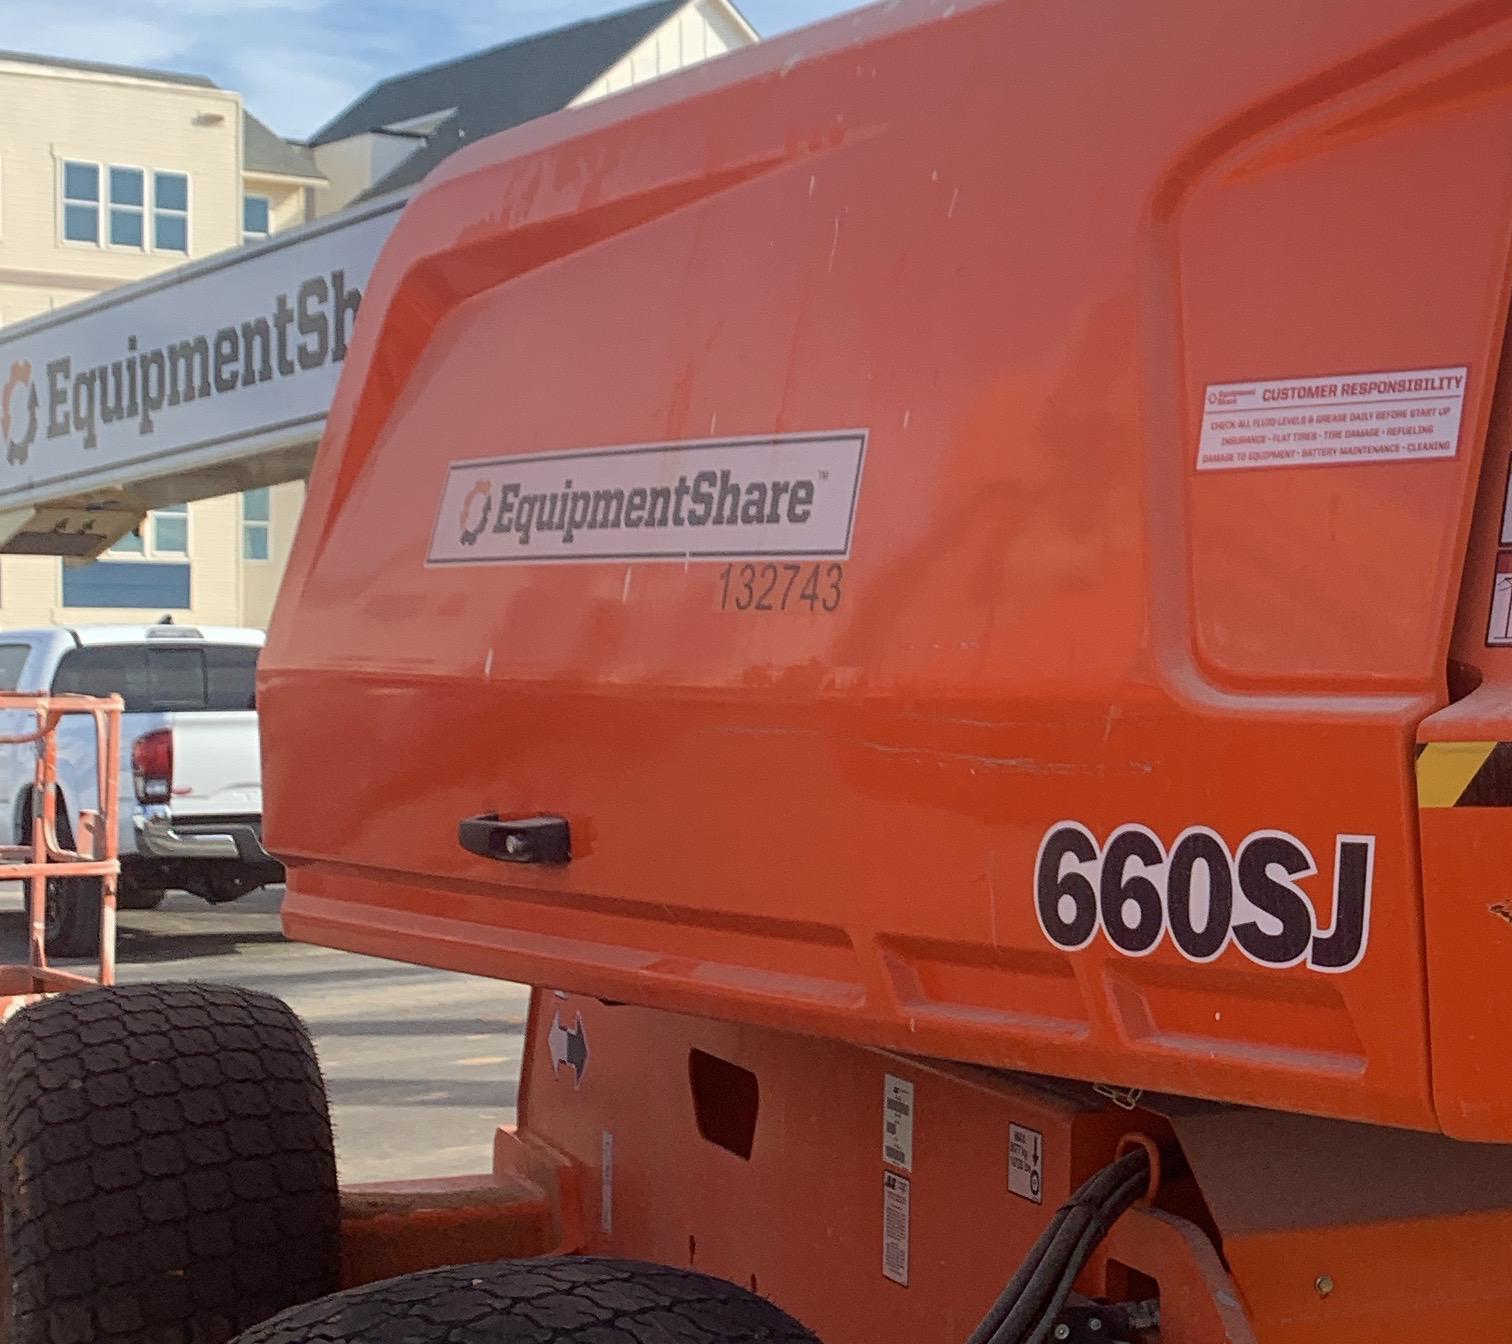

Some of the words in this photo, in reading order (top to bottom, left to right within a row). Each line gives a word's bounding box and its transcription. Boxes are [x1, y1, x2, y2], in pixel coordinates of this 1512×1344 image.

[1263, 384, 1337, 402] CUSTOMER
[1341, 376, 1463, 397] RESPONSIBILITY
[1301, 446, 1336, 457] BATTERY
[1340, 444, 1400, 455] MAINTENANCE
[1407, 441, 1451, 452] CLEANING
[493, 469, 814, 545] EquipmentShare
[719, 562, 844, 612] 132743
[1034, 820, 1376, 974] 660SJ
